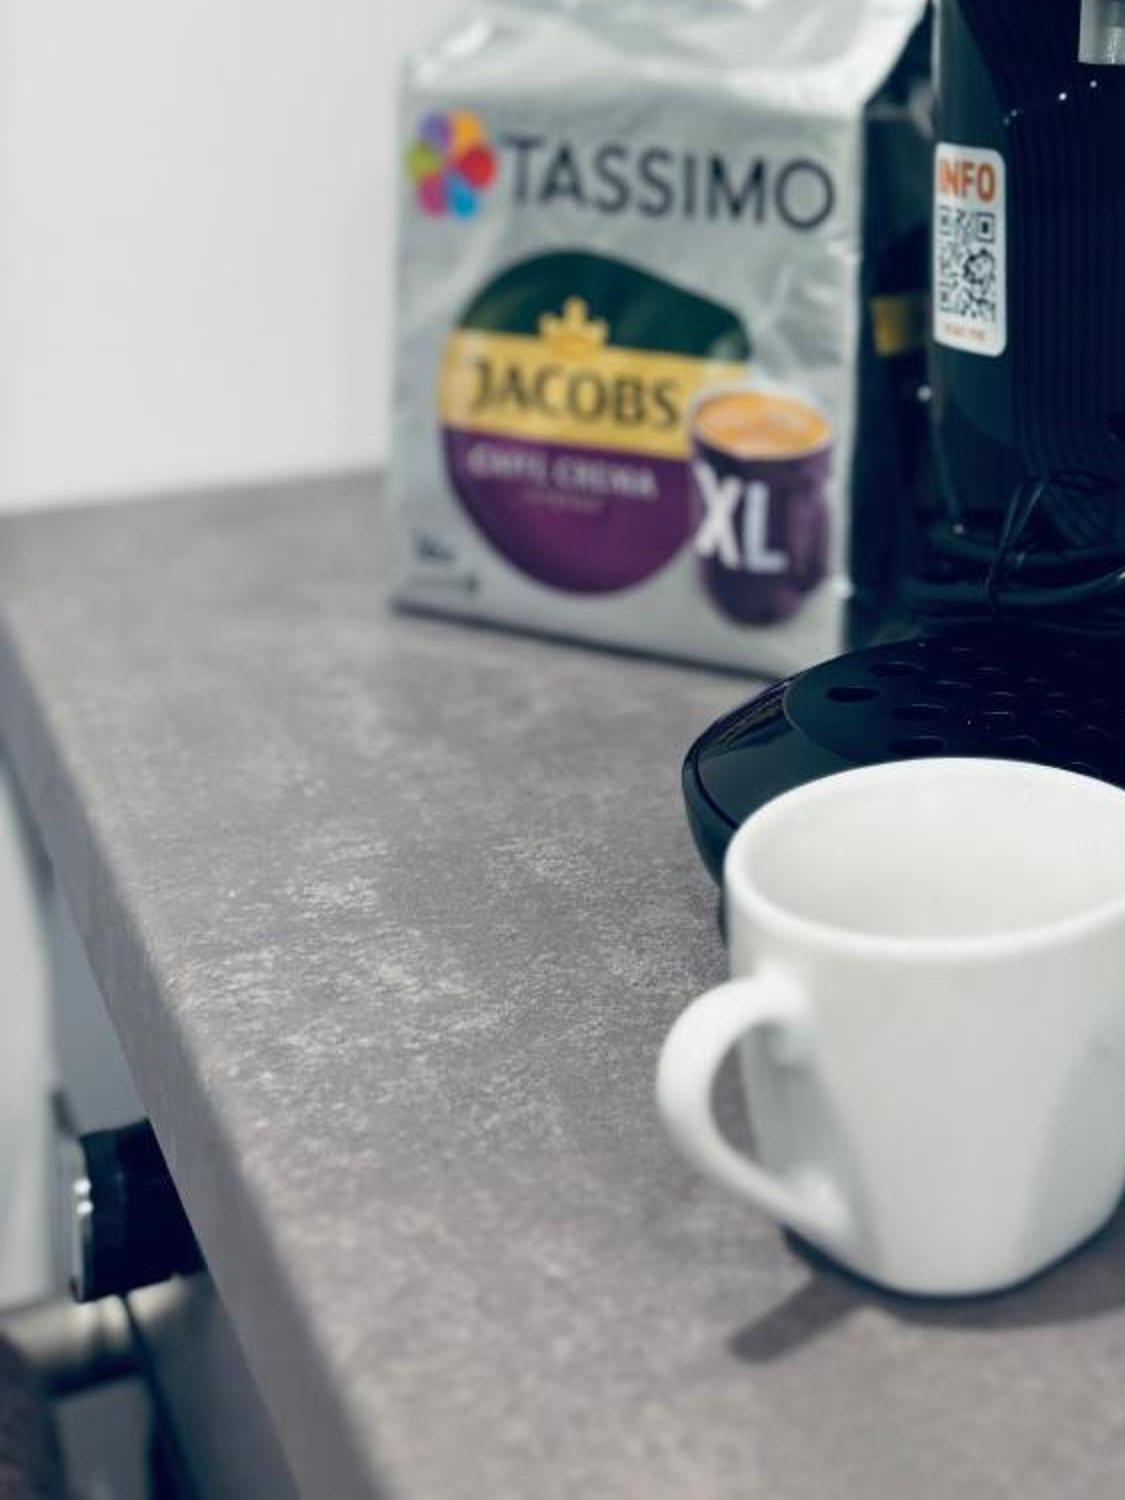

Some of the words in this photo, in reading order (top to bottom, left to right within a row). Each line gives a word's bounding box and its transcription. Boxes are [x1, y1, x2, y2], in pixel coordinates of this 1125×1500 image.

[502, 134, 836, 231] TASSIMO
[938, 159, 996, 204] INFO
[471, 356, 682, 433] JACOBS
[693, 457, 788, 574] XL
